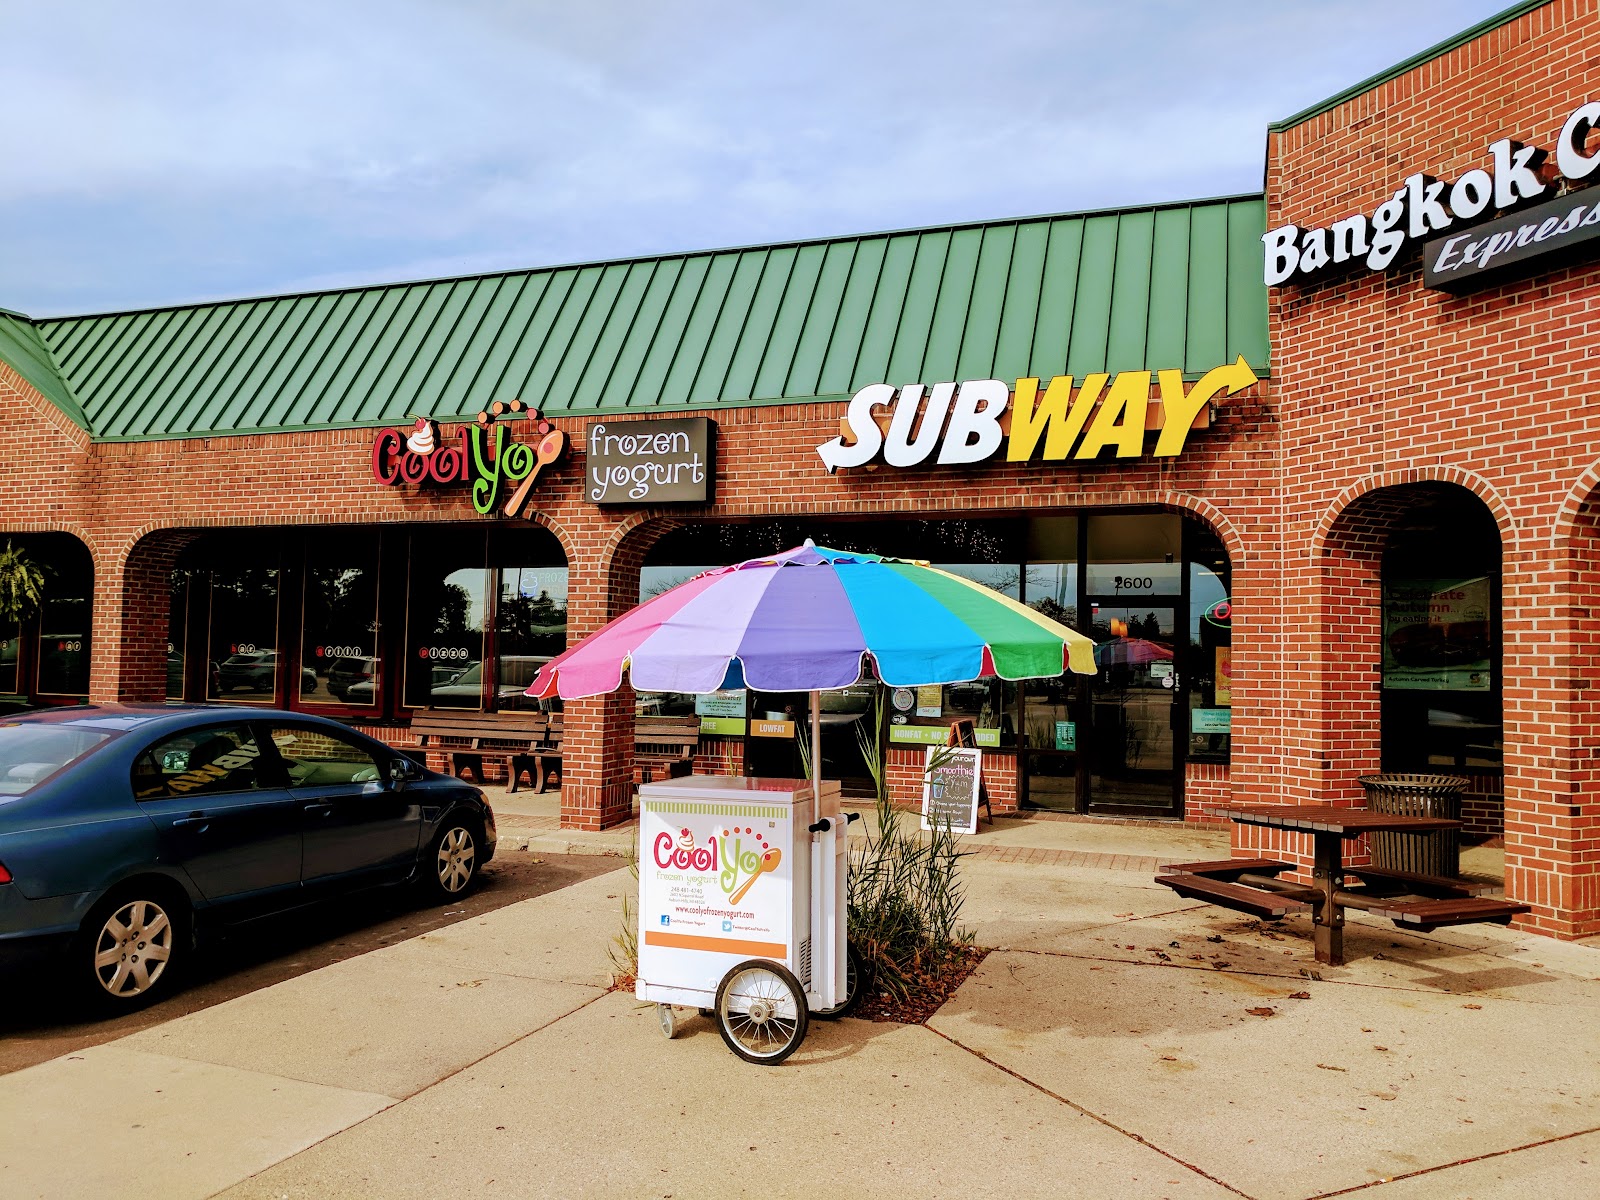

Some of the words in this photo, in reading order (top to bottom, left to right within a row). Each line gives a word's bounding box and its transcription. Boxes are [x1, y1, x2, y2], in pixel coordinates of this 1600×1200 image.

[1261, 138, 1546, 287] Bangkok
[815, 354, 1258, 474] SUBWAY
[590, 424, 690, 457] frozen
[591, 452, 704, 501] yogurt
[1115, 576, 1153, 589] 2600
[418, 646, 469, 660] pizza
[701, 721, 717, 730] FREE
[759, 723, 785, 733] LOWFAT
[894, 729, 922, 739] NONFAT
[931, 730, 942, 740] NO
[656, 870, 684, 882] frozen
[686, 875, 718, 887] yogurt
